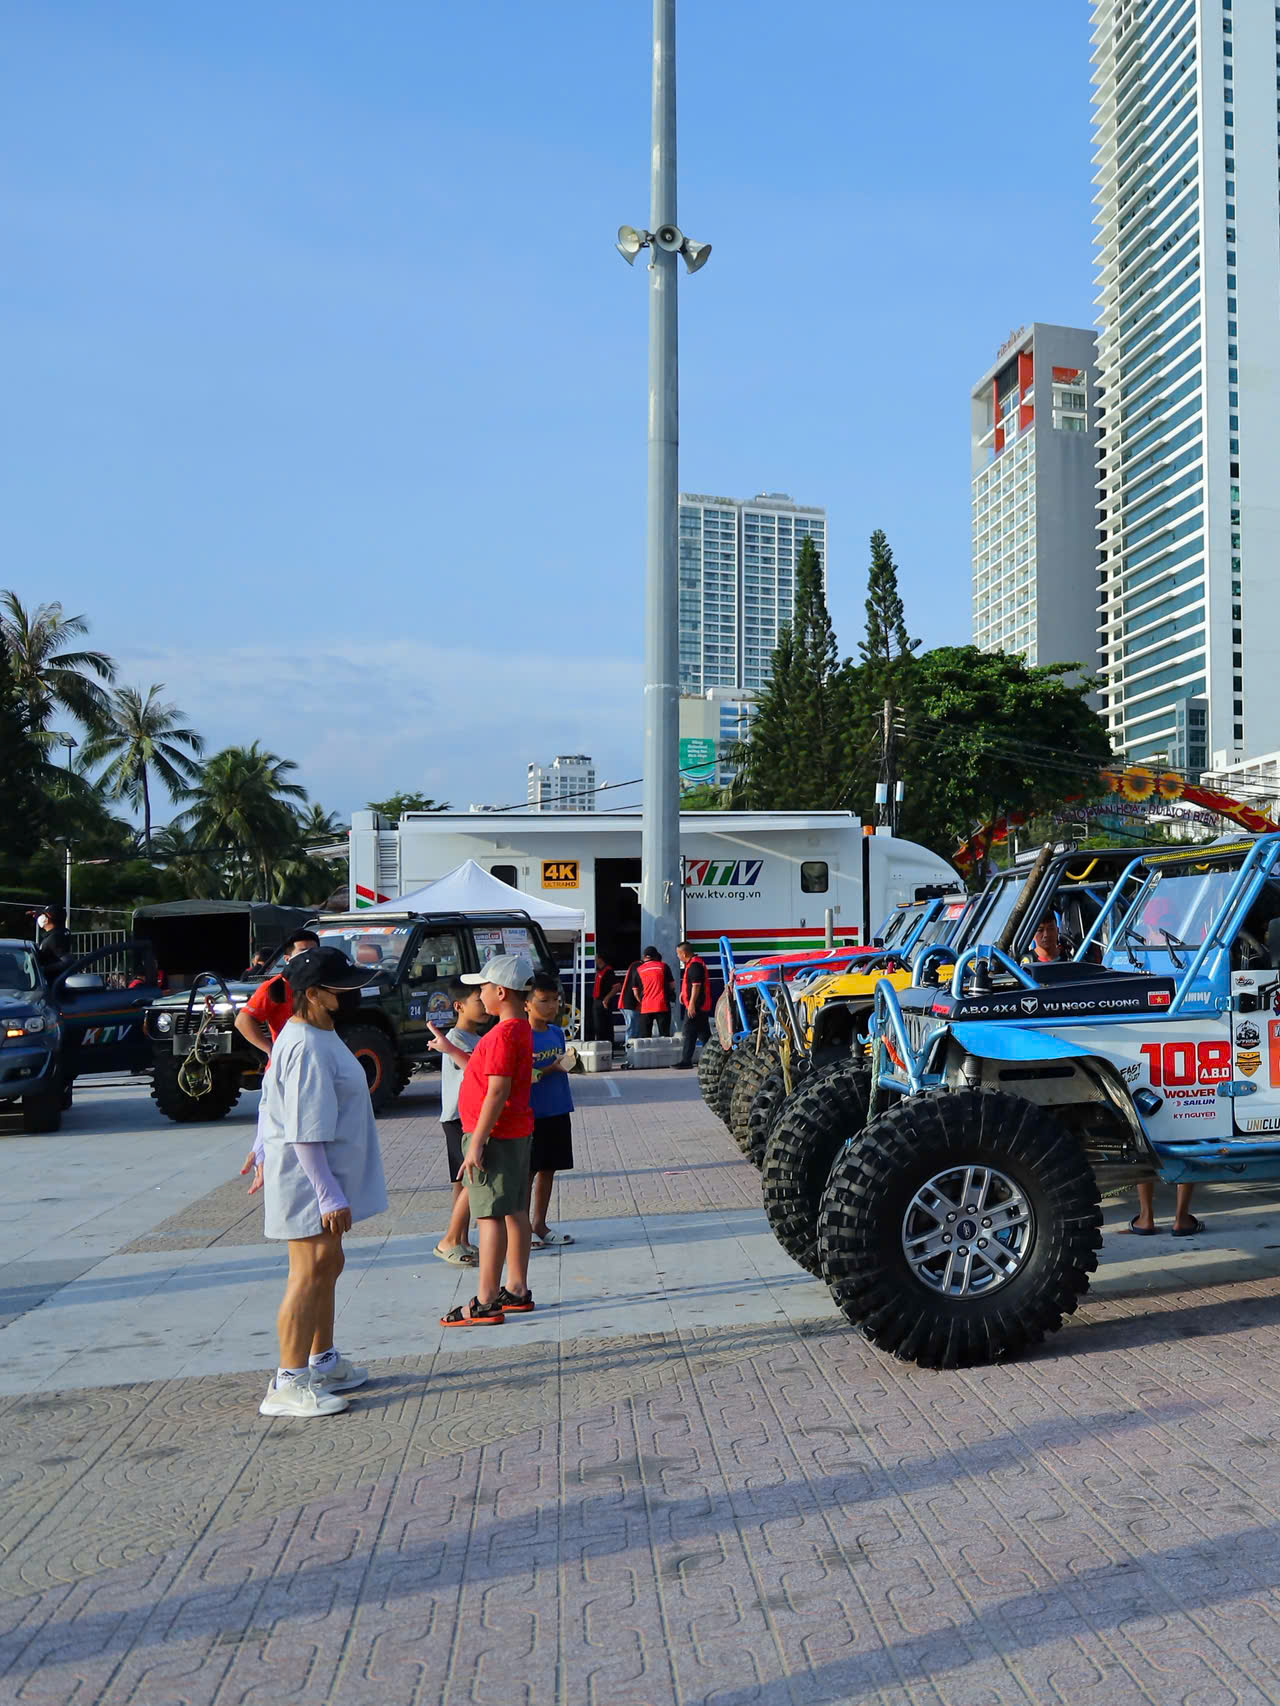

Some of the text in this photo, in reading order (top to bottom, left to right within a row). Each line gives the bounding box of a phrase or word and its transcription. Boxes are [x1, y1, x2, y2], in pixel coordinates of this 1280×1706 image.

[545, 864, 576, 880] 4K
[685, 860, 763, 886] KTV
[410, 1005, 421, 1016] 214
[993, 1004, 1017, 1013] 4X4
[1042, 1002, 1060, 1012] VU
[1061, 1000, 1096, 1011] NGOC
[1098, 998, 1140, 1009] CUONG
[81, 1024, 132, 1045] KTV
[1140, 1041, 1232, 1087] 108
[1163, 1088, 1216, 1099] WOLVER
[1183, 1098, 1216, 1107] SAILUN
